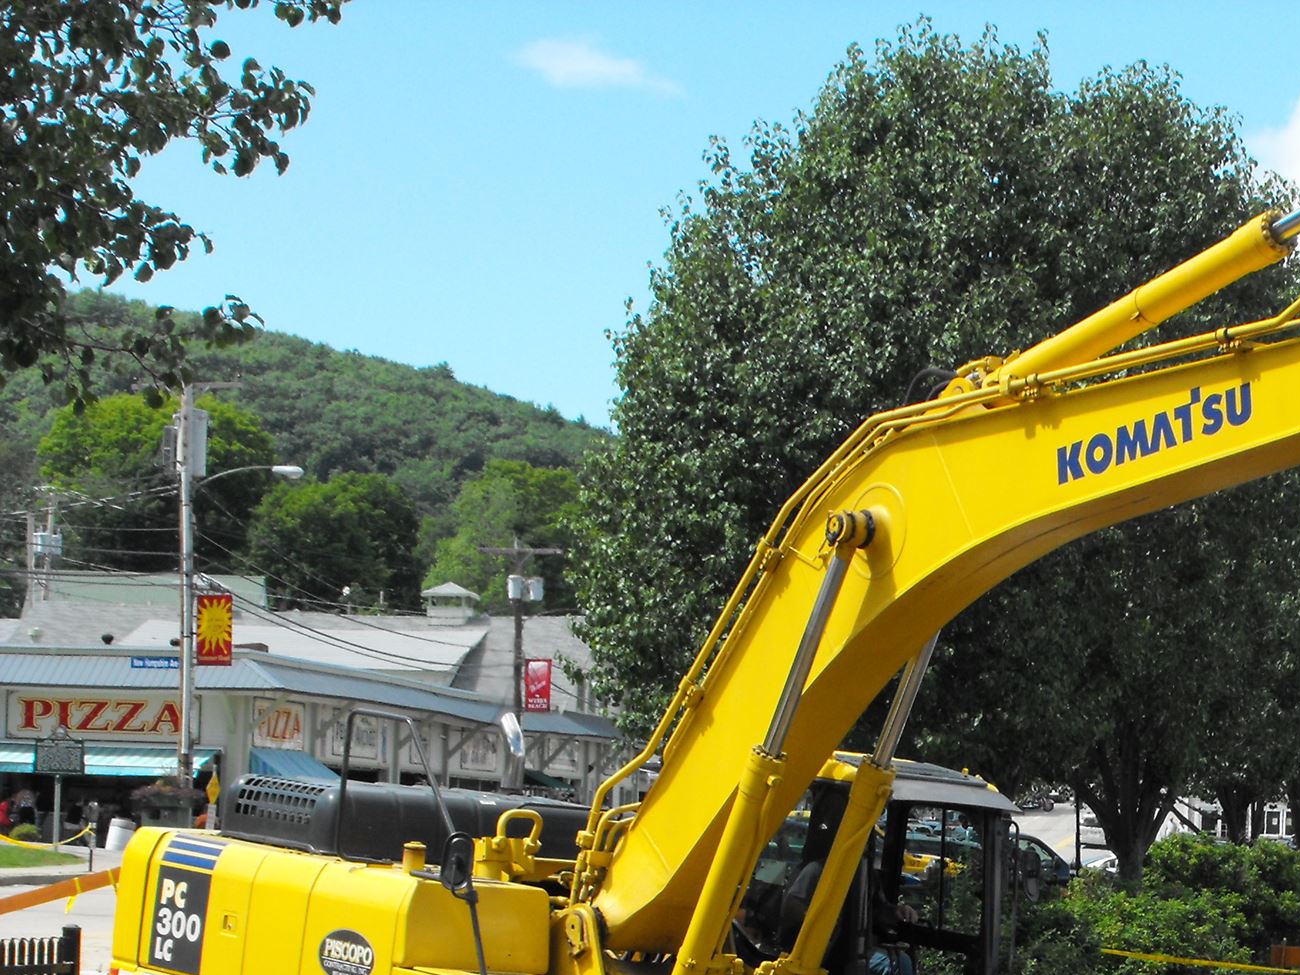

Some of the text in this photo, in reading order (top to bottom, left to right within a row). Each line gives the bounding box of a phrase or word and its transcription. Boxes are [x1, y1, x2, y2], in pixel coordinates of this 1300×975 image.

[1057, 381, 1252, 485] KOMATSU
[18, 696, 182, 736] PIZZA
[257, 704, 301, 742] PIZZA
[160, 878, 188, 908] PC
[156, 907, 201, 942] 300
[154, 936, 174, 961] LC
[323, 938, 372, 966] PISCOPO
